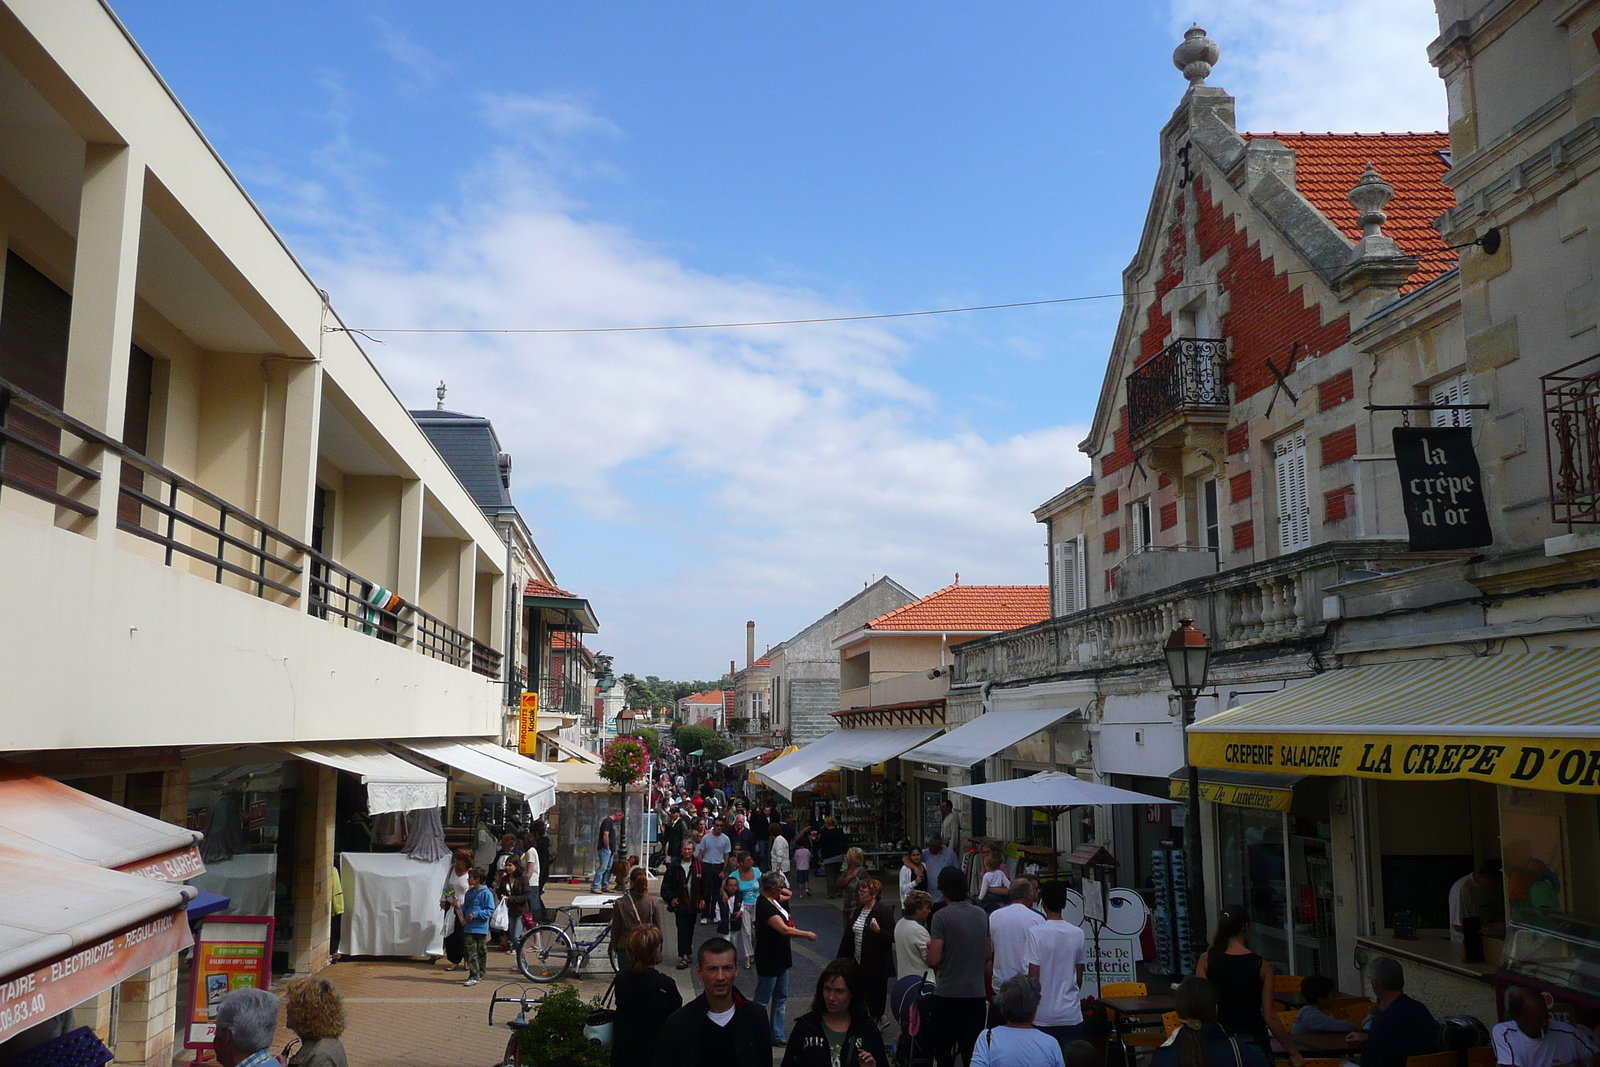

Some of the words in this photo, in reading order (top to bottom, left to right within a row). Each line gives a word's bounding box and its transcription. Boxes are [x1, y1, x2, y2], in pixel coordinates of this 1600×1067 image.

[1420, 437, 1448, 466] la
[1410, 471, 1475, 504] crêpe
[1421, 498, 1470, 526] d'or
[1225, 743, 1274, 766] CREPERIE
[1281, 745, 1343, 768] SALADERIE
[1356, 743, 1393, 773] LA
[1403, 744, 1506, 776] CREPE
[1213, 786, 1226, 802] De
[1115, 948, 1129, 958] De
